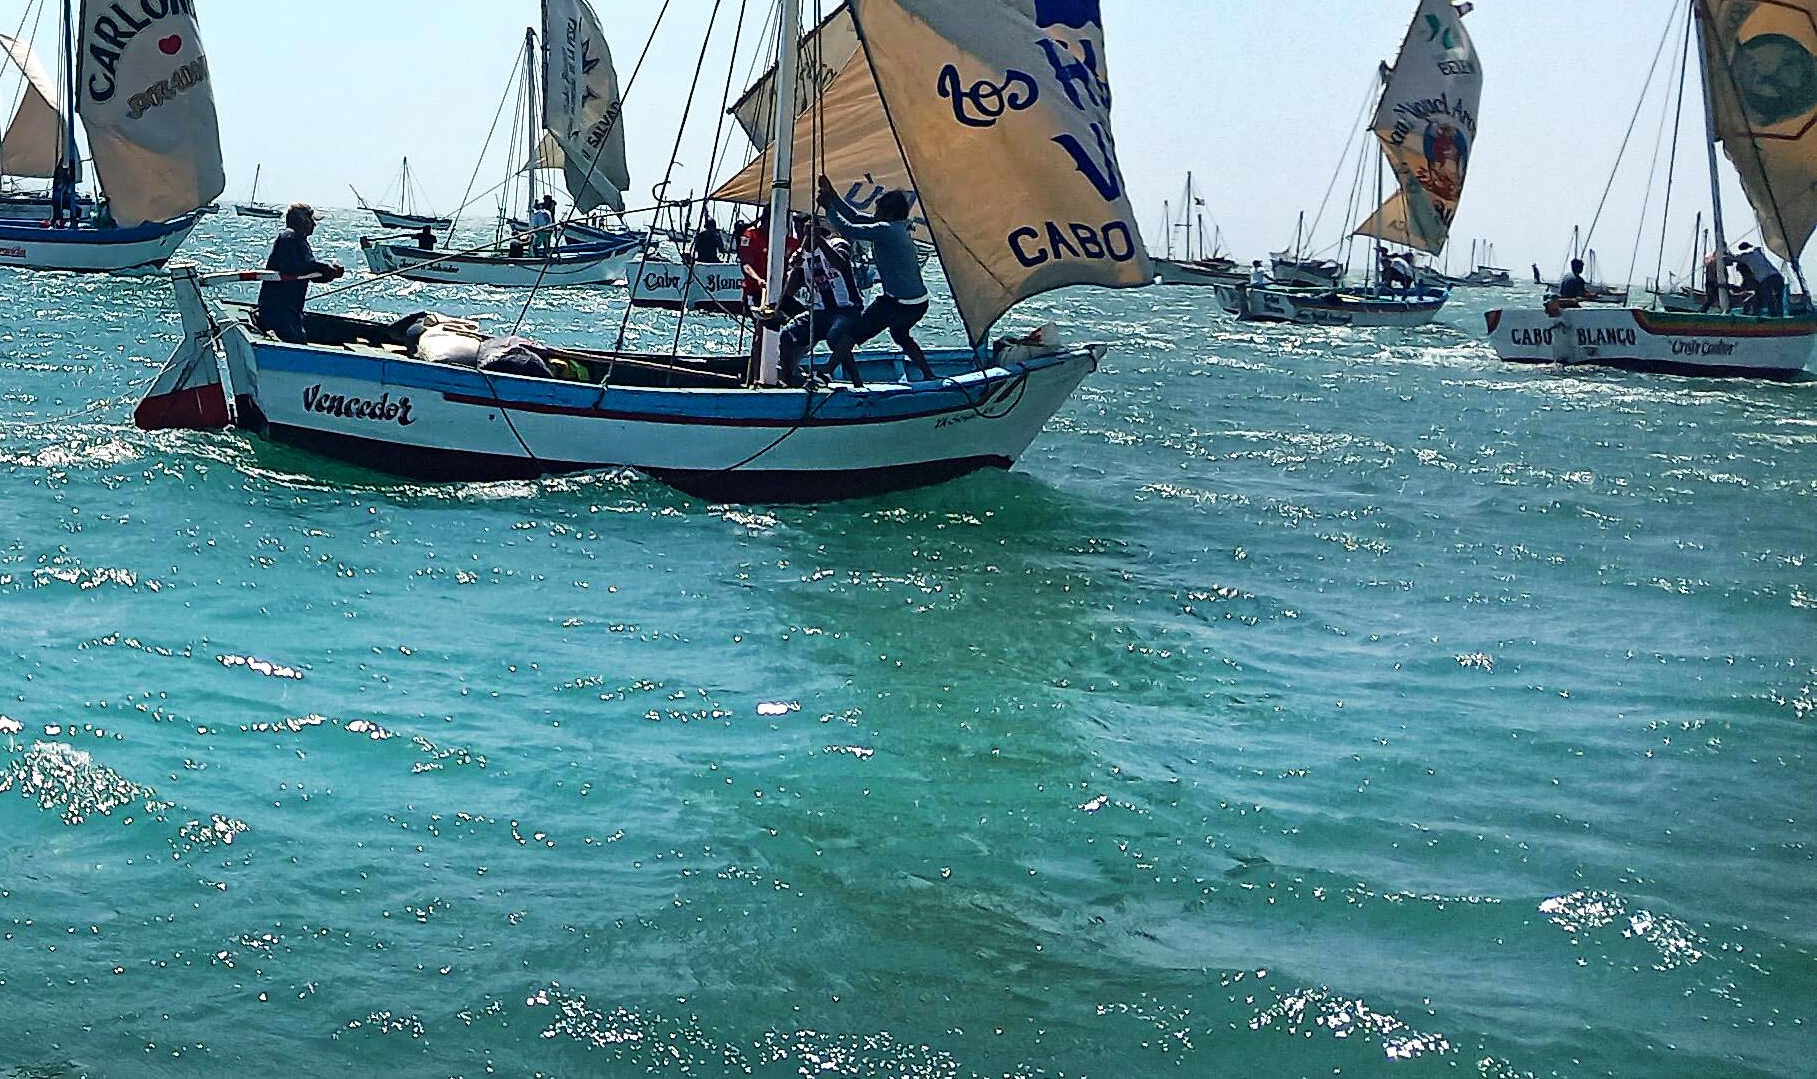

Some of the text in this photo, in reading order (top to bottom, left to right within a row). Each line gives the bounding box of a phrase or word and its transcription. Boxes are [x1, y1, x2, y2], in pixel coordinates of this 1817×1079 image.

[936, 63, 1040, 128] Los
[1007, 220, 1135, 269] CABO
[1511, 328, 1637, 346] CABO BLANCO
[302, 383, 416, 427] Vencedor
